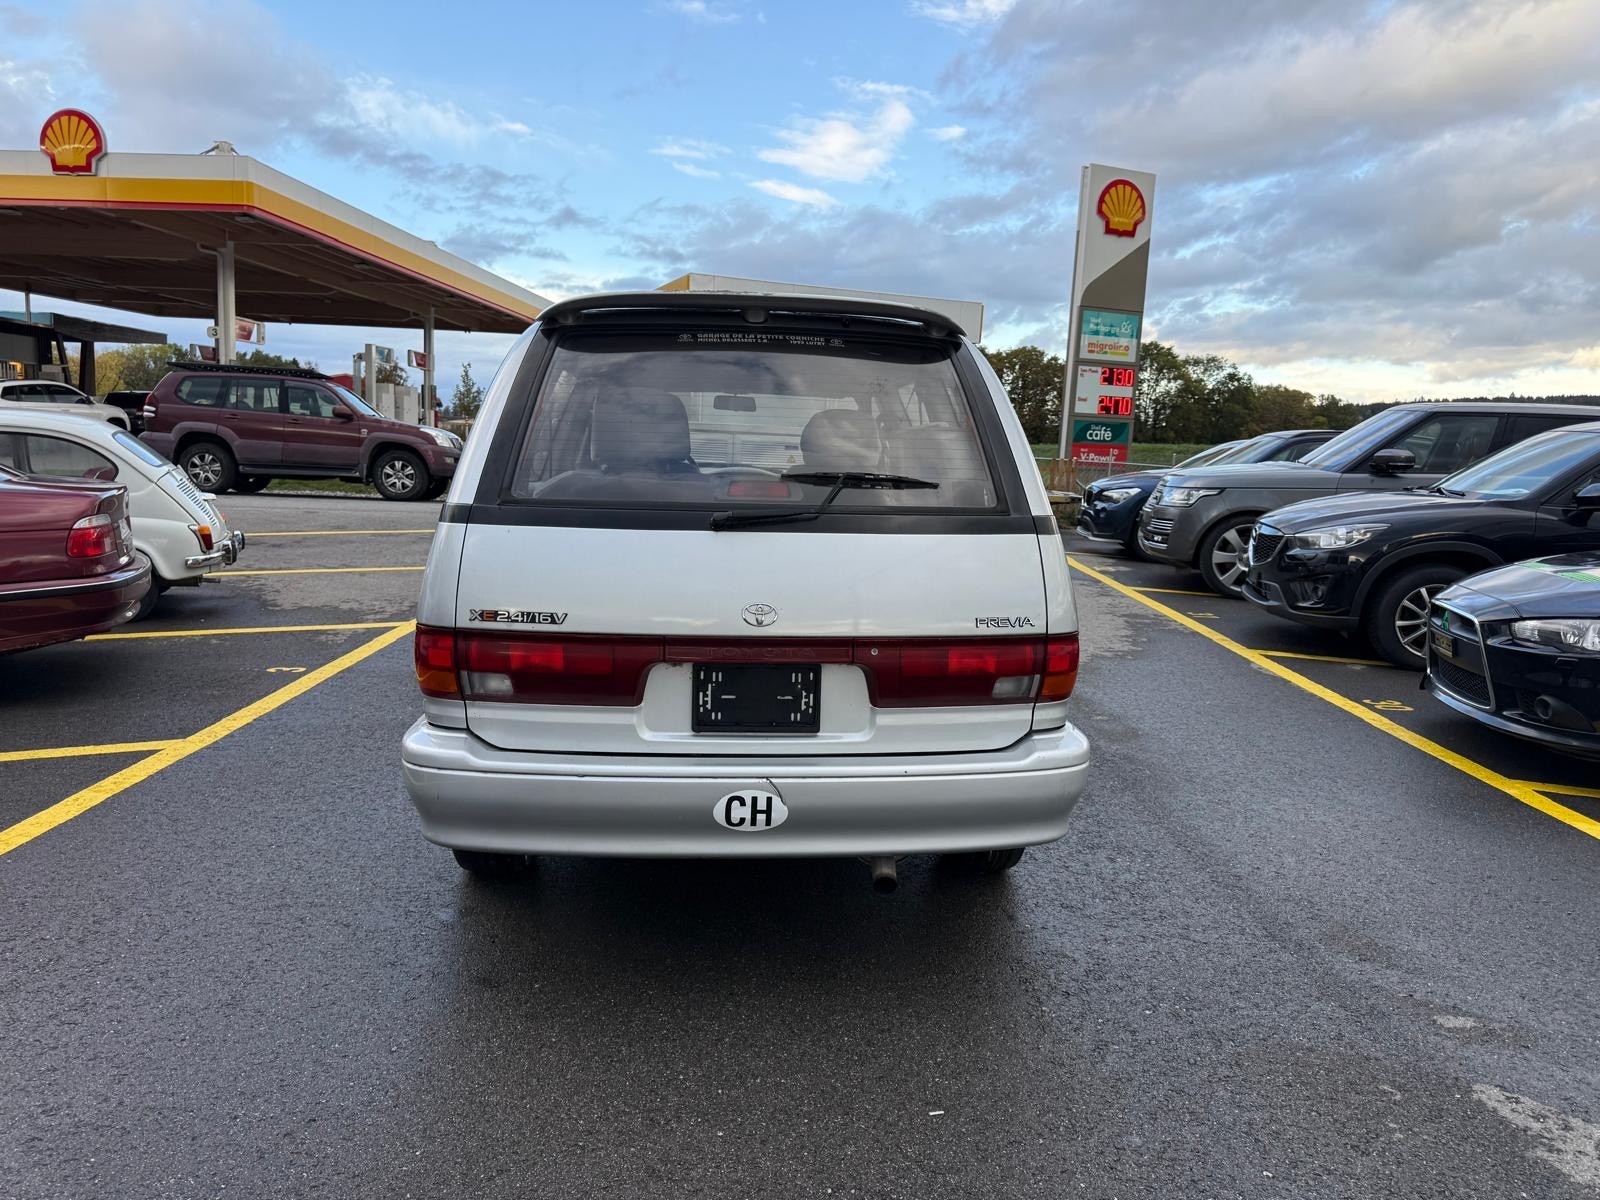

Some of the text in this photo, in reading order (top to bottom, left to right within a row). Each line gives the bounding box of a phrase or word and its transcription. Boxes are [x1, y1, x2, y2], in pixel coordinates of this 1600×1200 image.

[211, 328, 218, 336] 3
[1087, 341, 1130, 352] migrolico
[1086, 427, 1113, 441] café
[975, 616, 1036, 629] PREVIA
[724, 794, 773, 828] CH
